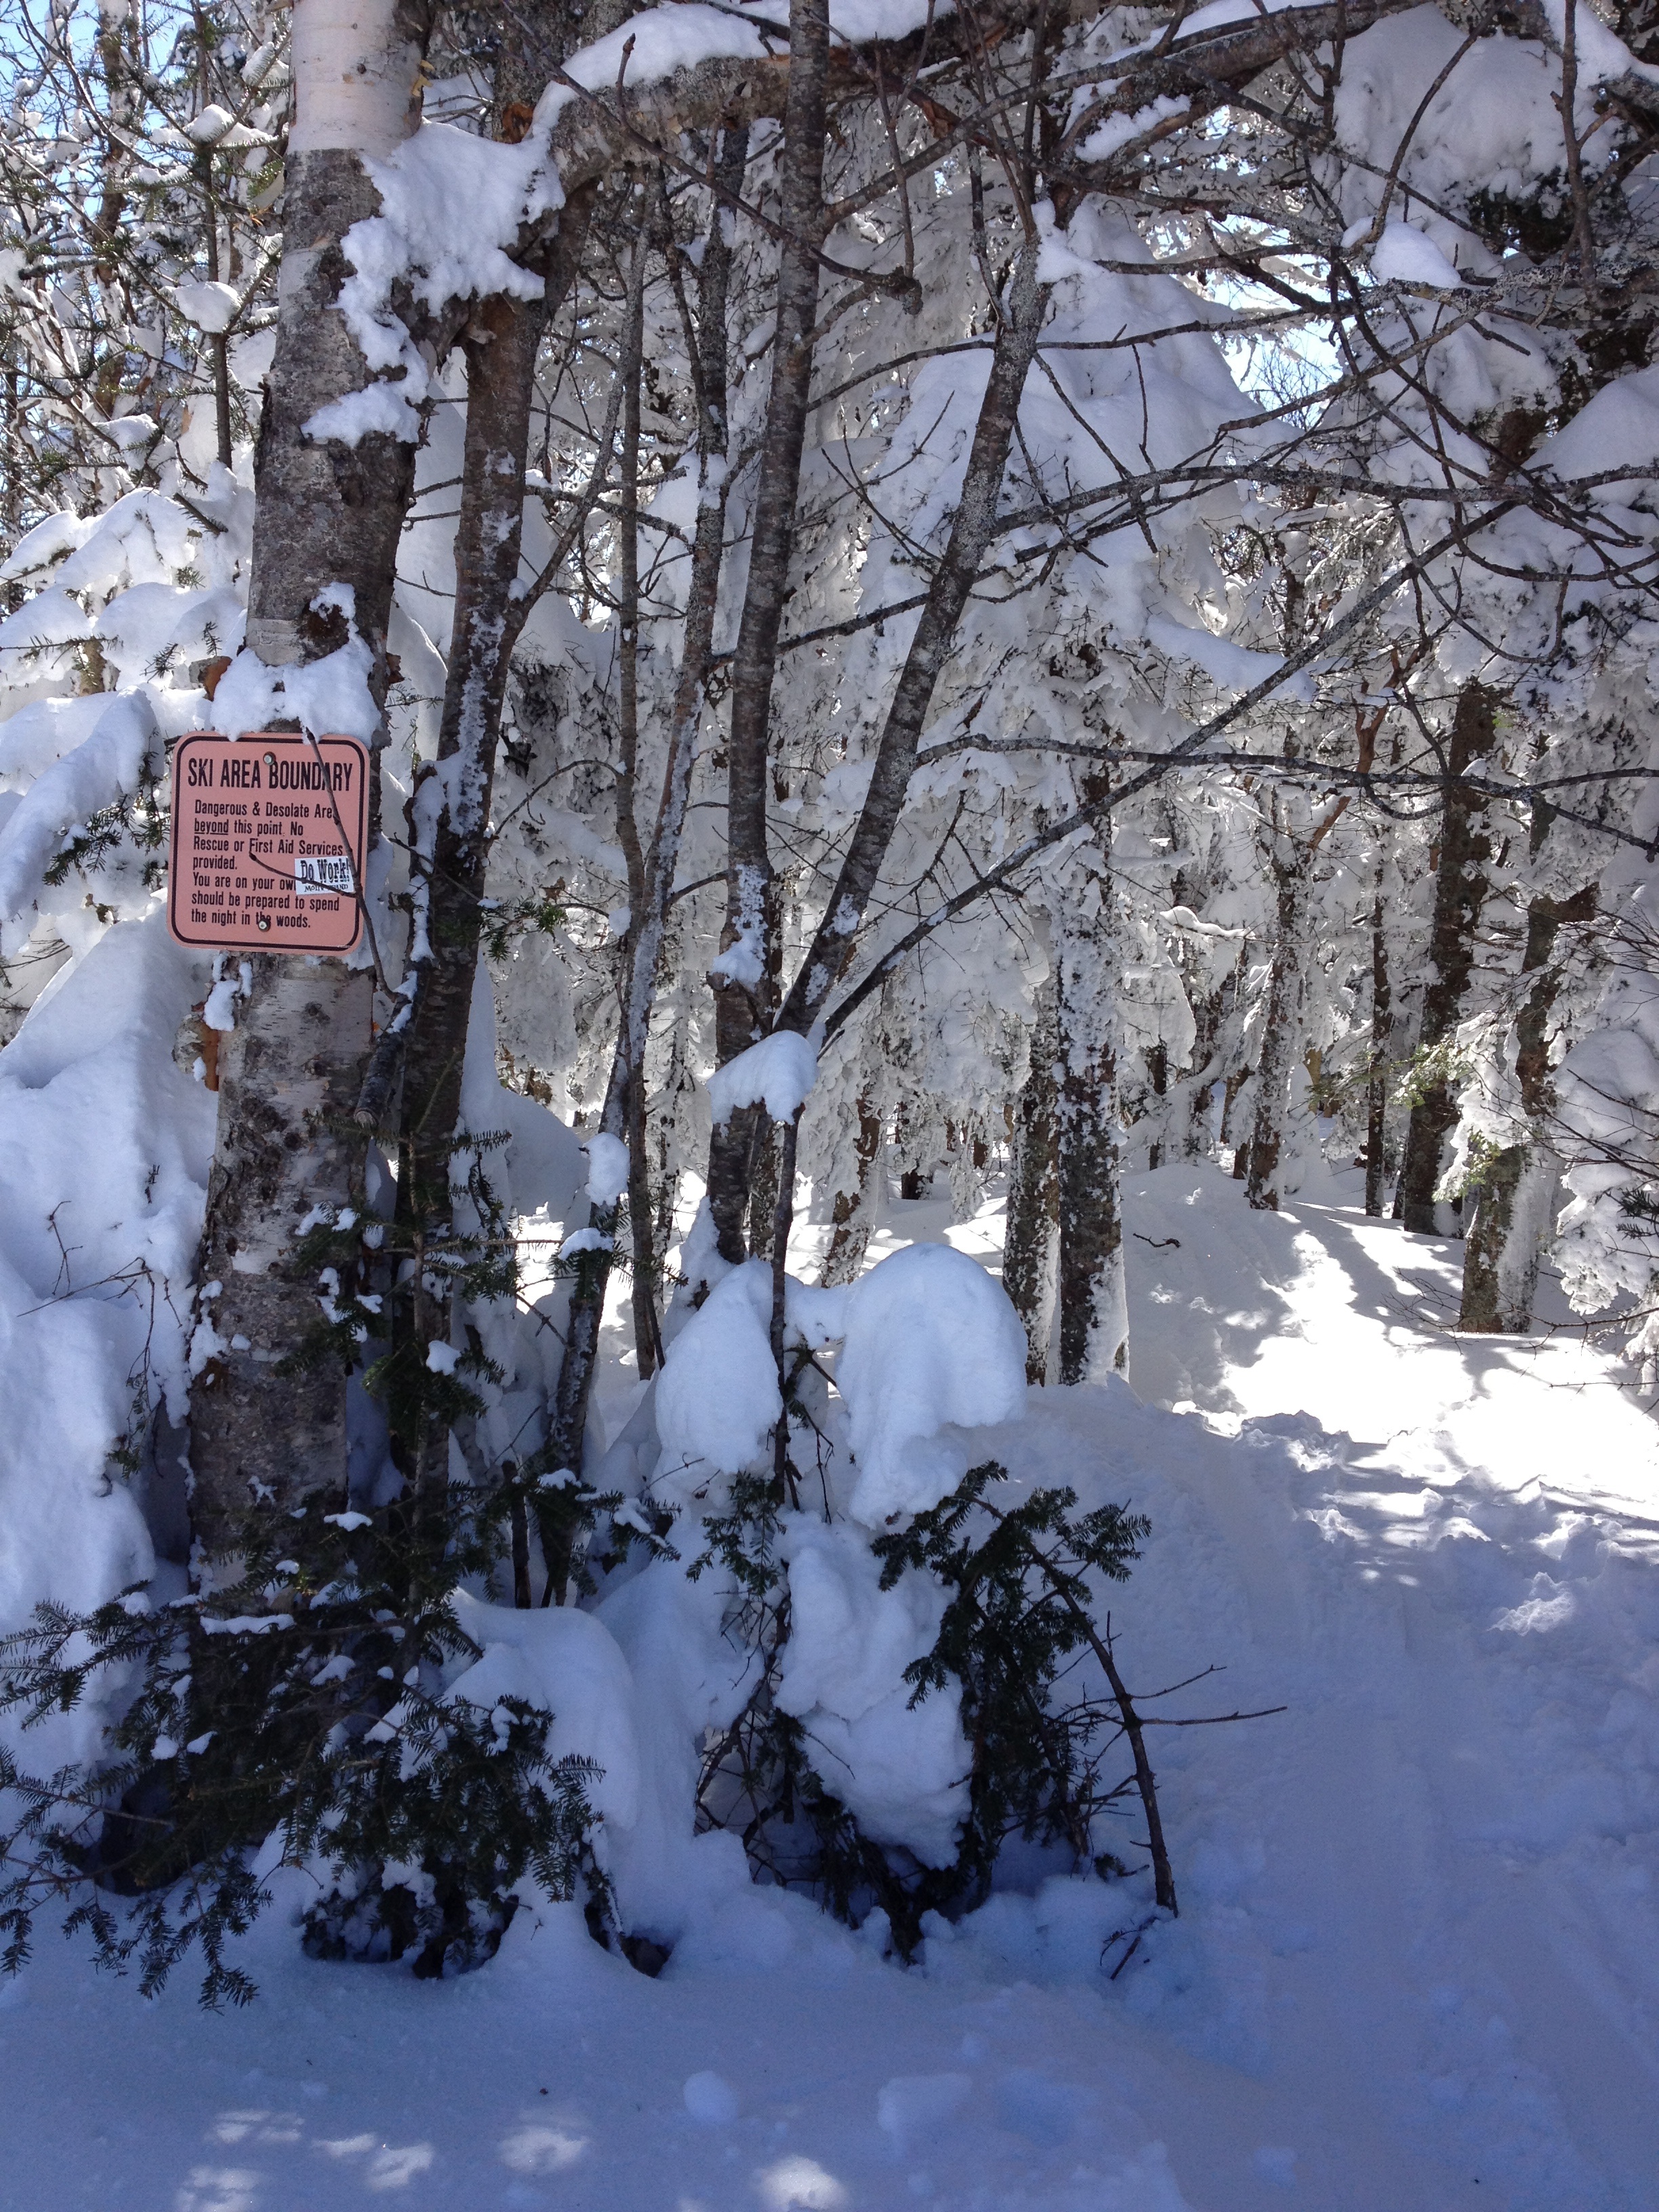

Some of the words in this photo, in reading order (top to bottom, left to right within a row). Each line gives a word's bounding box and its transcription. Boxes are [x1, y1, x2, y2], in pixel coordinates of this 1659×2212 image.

[188, 758, 213, 787] SKI
[220, 759, 261, 788] AREA
[268, 760, 353, 791] BOUNDARY
[194, 799, 247, 816] Dangerous
[252, 802, 260, 815] &
[266, 802, 310, 818] Desolate
[314, 804, 339, 819] Are
[194, 818, 228, 834] beyond
[234, 820, 252, 834] this
[291, 823, 304, 836] No
[194, 836, 229, 851] Rescue
[234, 840, 245, 852] or
[249, 838, 272, 853] First
[278, 839, 293, 854] Aid
[299, 841, 343, 856] Services
[193, 855, 237, 870] provided.
[300, 860, 315, 879] Do
[317, 858, 350, 882] Work!
[193, 872, 209, 886] You
[215, 876, 230, 888] are
[235, 878, 247, 888] on
[253, 879, 273, 890] your
[192, 893, 224, 906] should
[229, 893, 240, 906] be
[245, 896, 289, 910] prepared
[295, 897, 305, 909] to
[310, 897, 340, 912] spend
[192, 909, 207, 924] the
[211, 909, 237, 926] night
[241, 911, 250, 925] in
[255, 911, 272, 926] the
[276, 914, 310, 928] woods.
